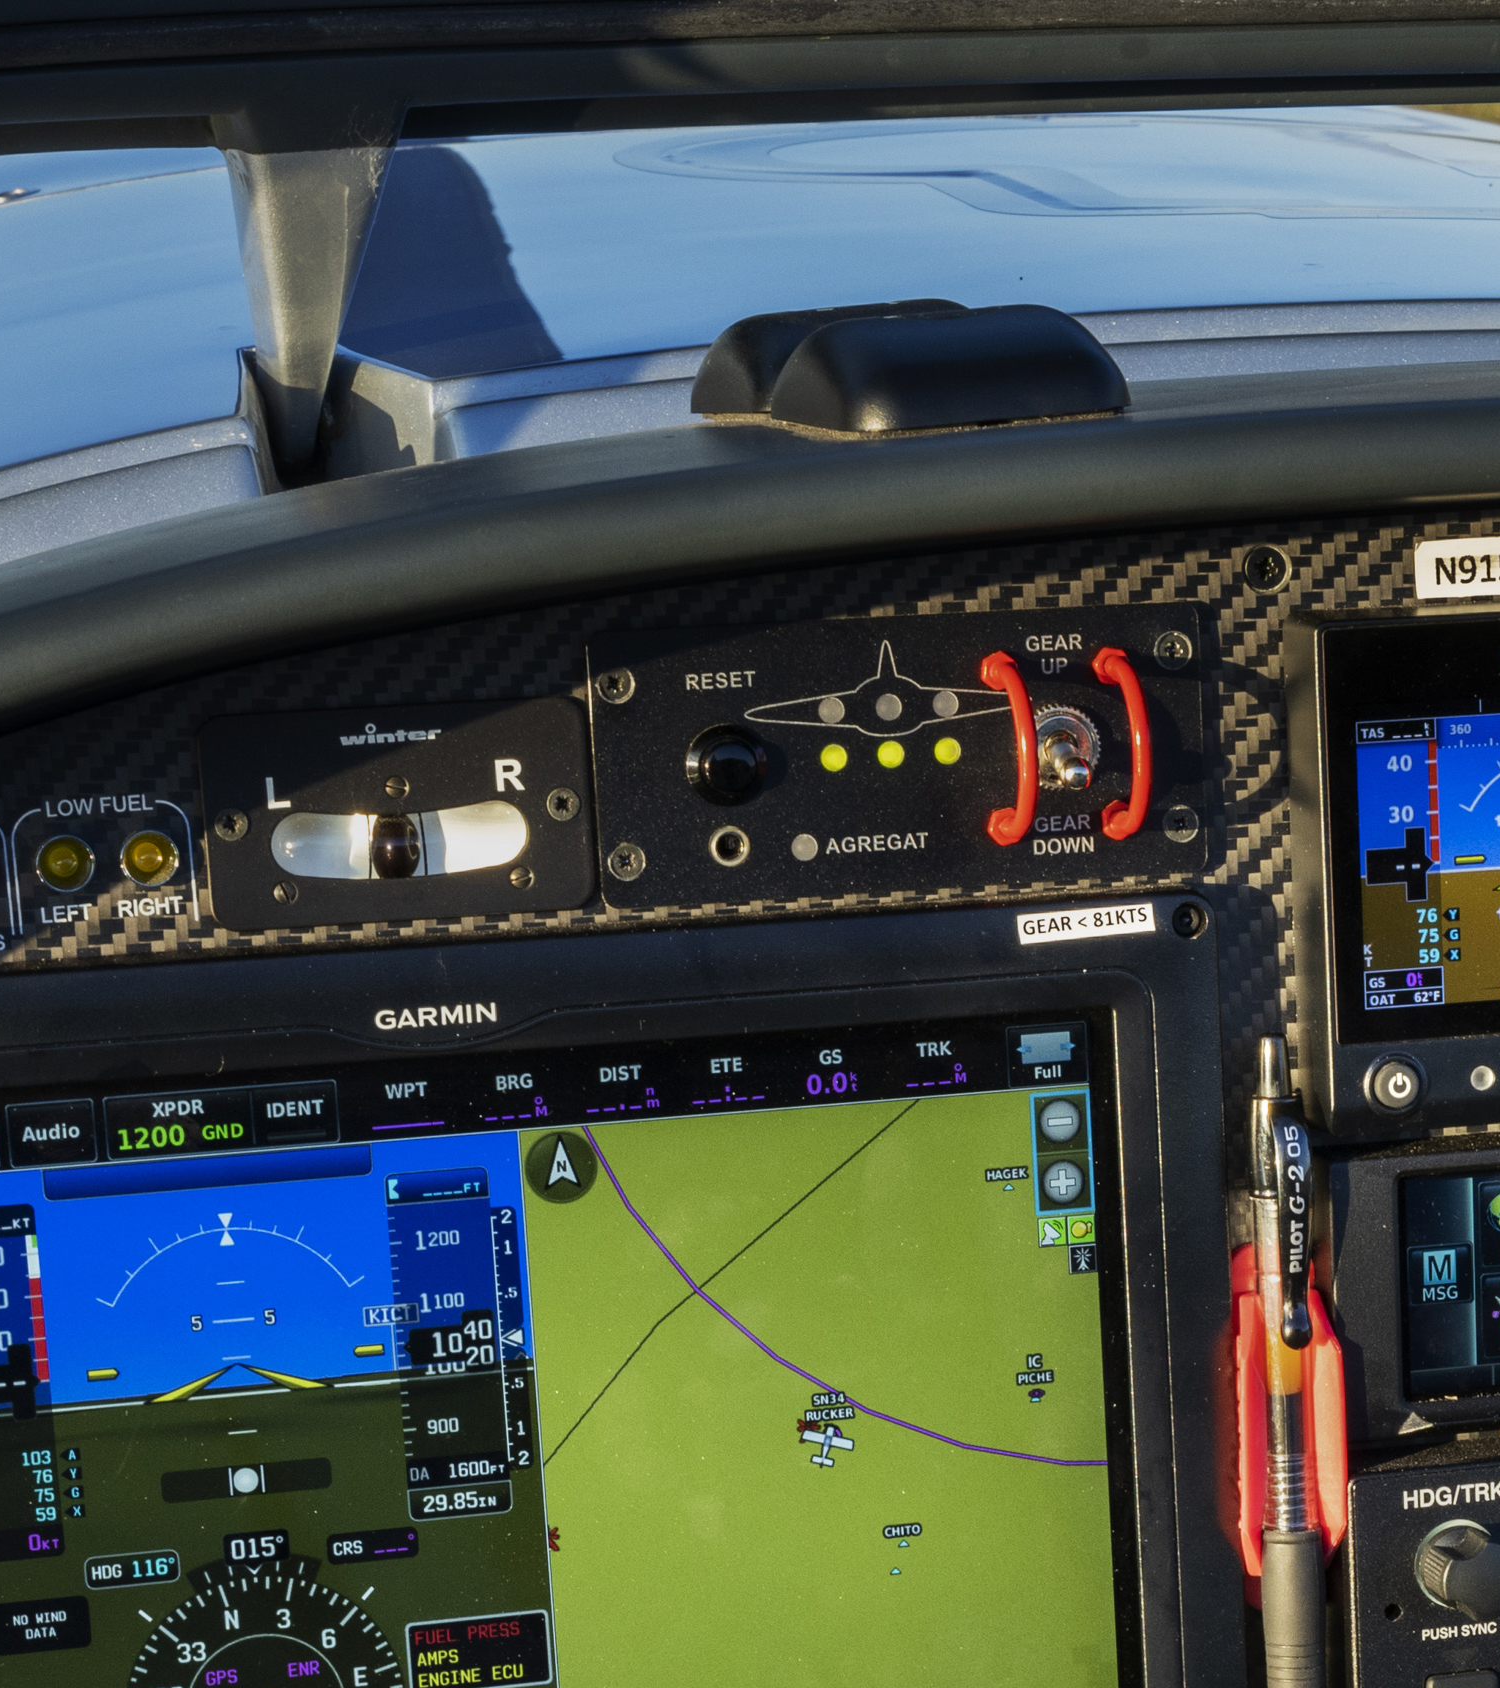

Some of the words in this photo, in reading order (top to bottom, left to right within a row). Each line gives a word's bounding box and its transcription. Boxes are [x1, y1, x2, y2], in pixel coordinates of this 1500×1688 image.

[1025, 633, 1083, 653] GEAR
[1040, 658, 1068, 674] UP
[684, 670, 756, 691] RESET
[339, 723, 442, 746] winter
[45, 798, 92, 818] LOW
[98, 793, 154, 815] FUEL
[1034, 814, 1091, 834] GEAR
[825, 832, 928, 855] AGREGAT
[1032, 836, 1095, 856] DOWN
[40, 902, 91, 926] LEFT
[117, 895, 184, 919] RIGHT
[1022, 915, 1073, 937] GEAR
[1092, 906, 1148, 929] 81KTS
[374, 1003, 498, 1031] GARMIN
[916, 1041, 953, 1059] TRK
[495, 1072, 534, 1092] BRG
[599, 1064, 642, 1084] DIST
[1033, 1062, 1062, 1081] Full
[151, 1099, 205, 1119] XPDR
[21, 1122, 81, 1143] Audio
[117, 1125, 186, 1152] 1200
[1284, 1126, 1301, 1157] 05
[986, 1167, 1028, 1183] HAGEK
[1288, 1165, 1305, 1214] G-2
[1289, 1220, 1304, 1273] PILOT
[13, 1612, 29, 1626] NO
[34, 1609, 67, 1624] WIND
[25, 1626, 57, 1640] DATA
[418, 1670, 480, 1688] ENGINE
[492, 1663, 525, 1682] ECU
